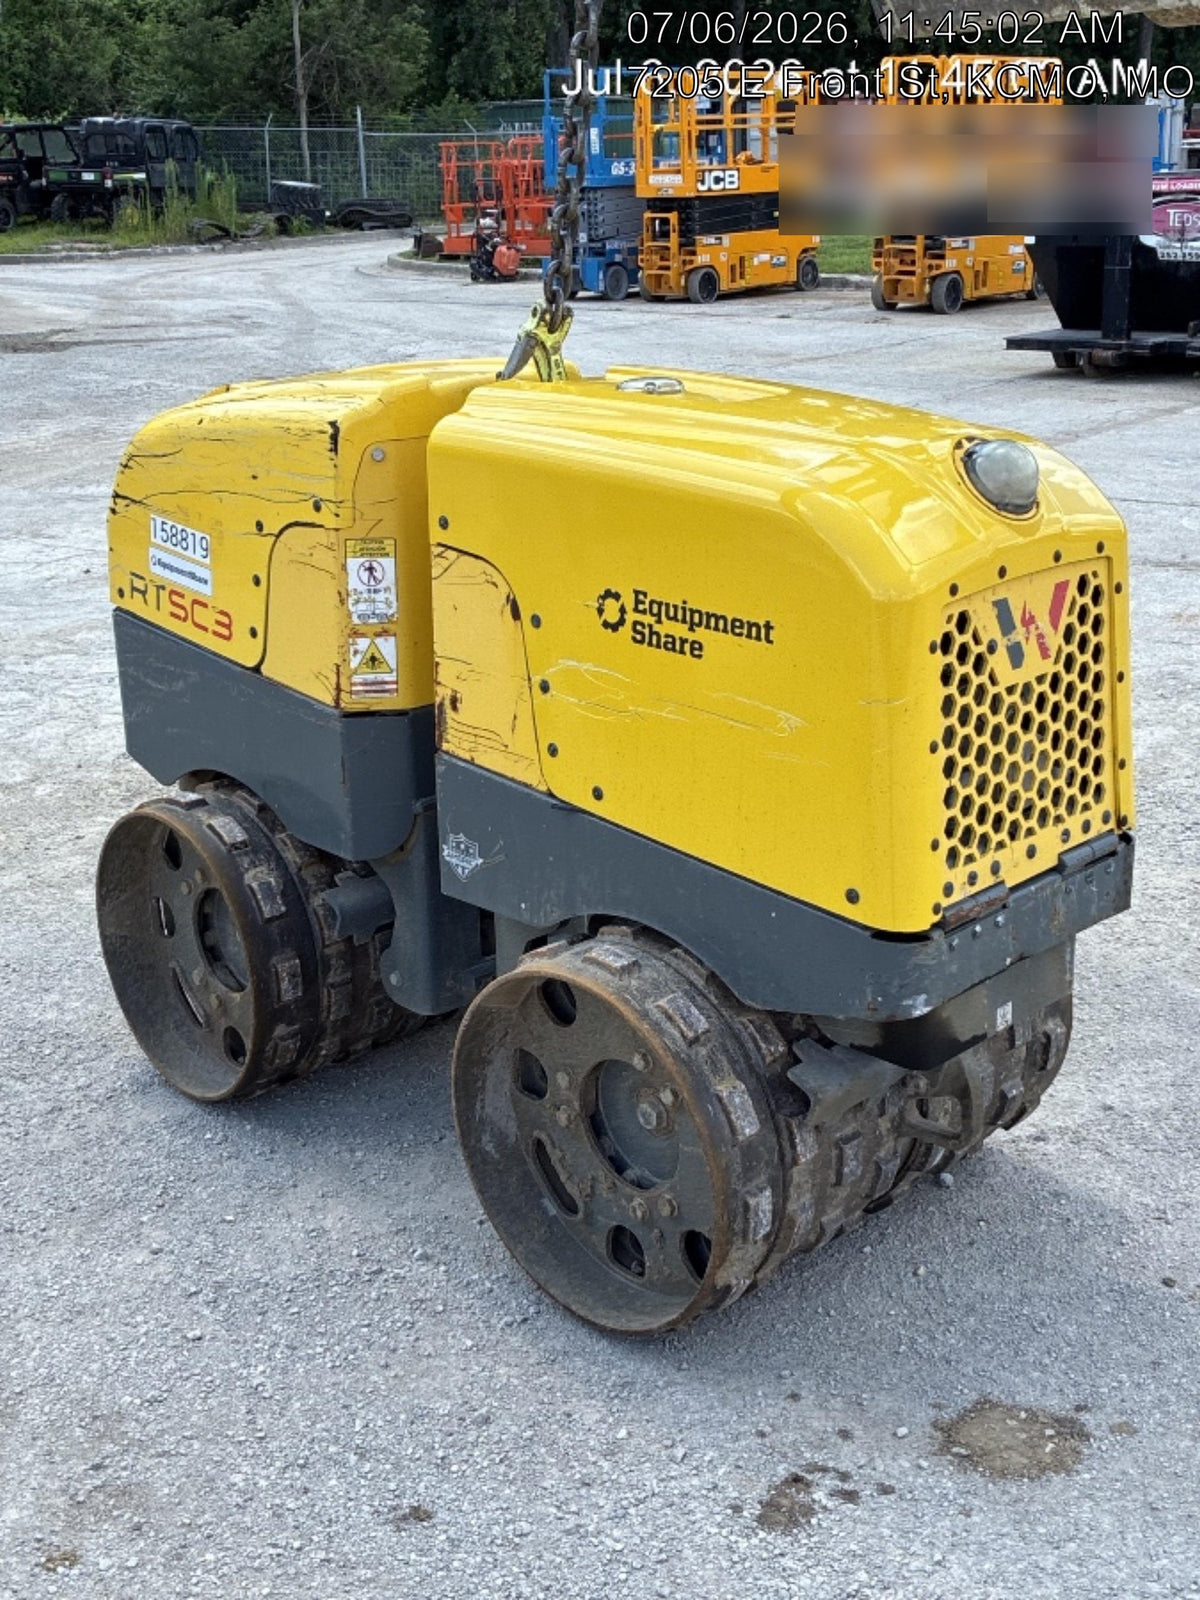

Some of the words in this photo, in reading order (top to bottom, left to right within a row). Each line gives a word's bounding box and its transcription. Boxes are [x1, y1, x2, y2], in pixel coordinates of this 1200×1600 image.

[697, 169, 739, 192] JCB
[151, 517, 209, 559] 158819
[632, 588, 775, 645] Equipment
[631, 619, 704, 660] Share
